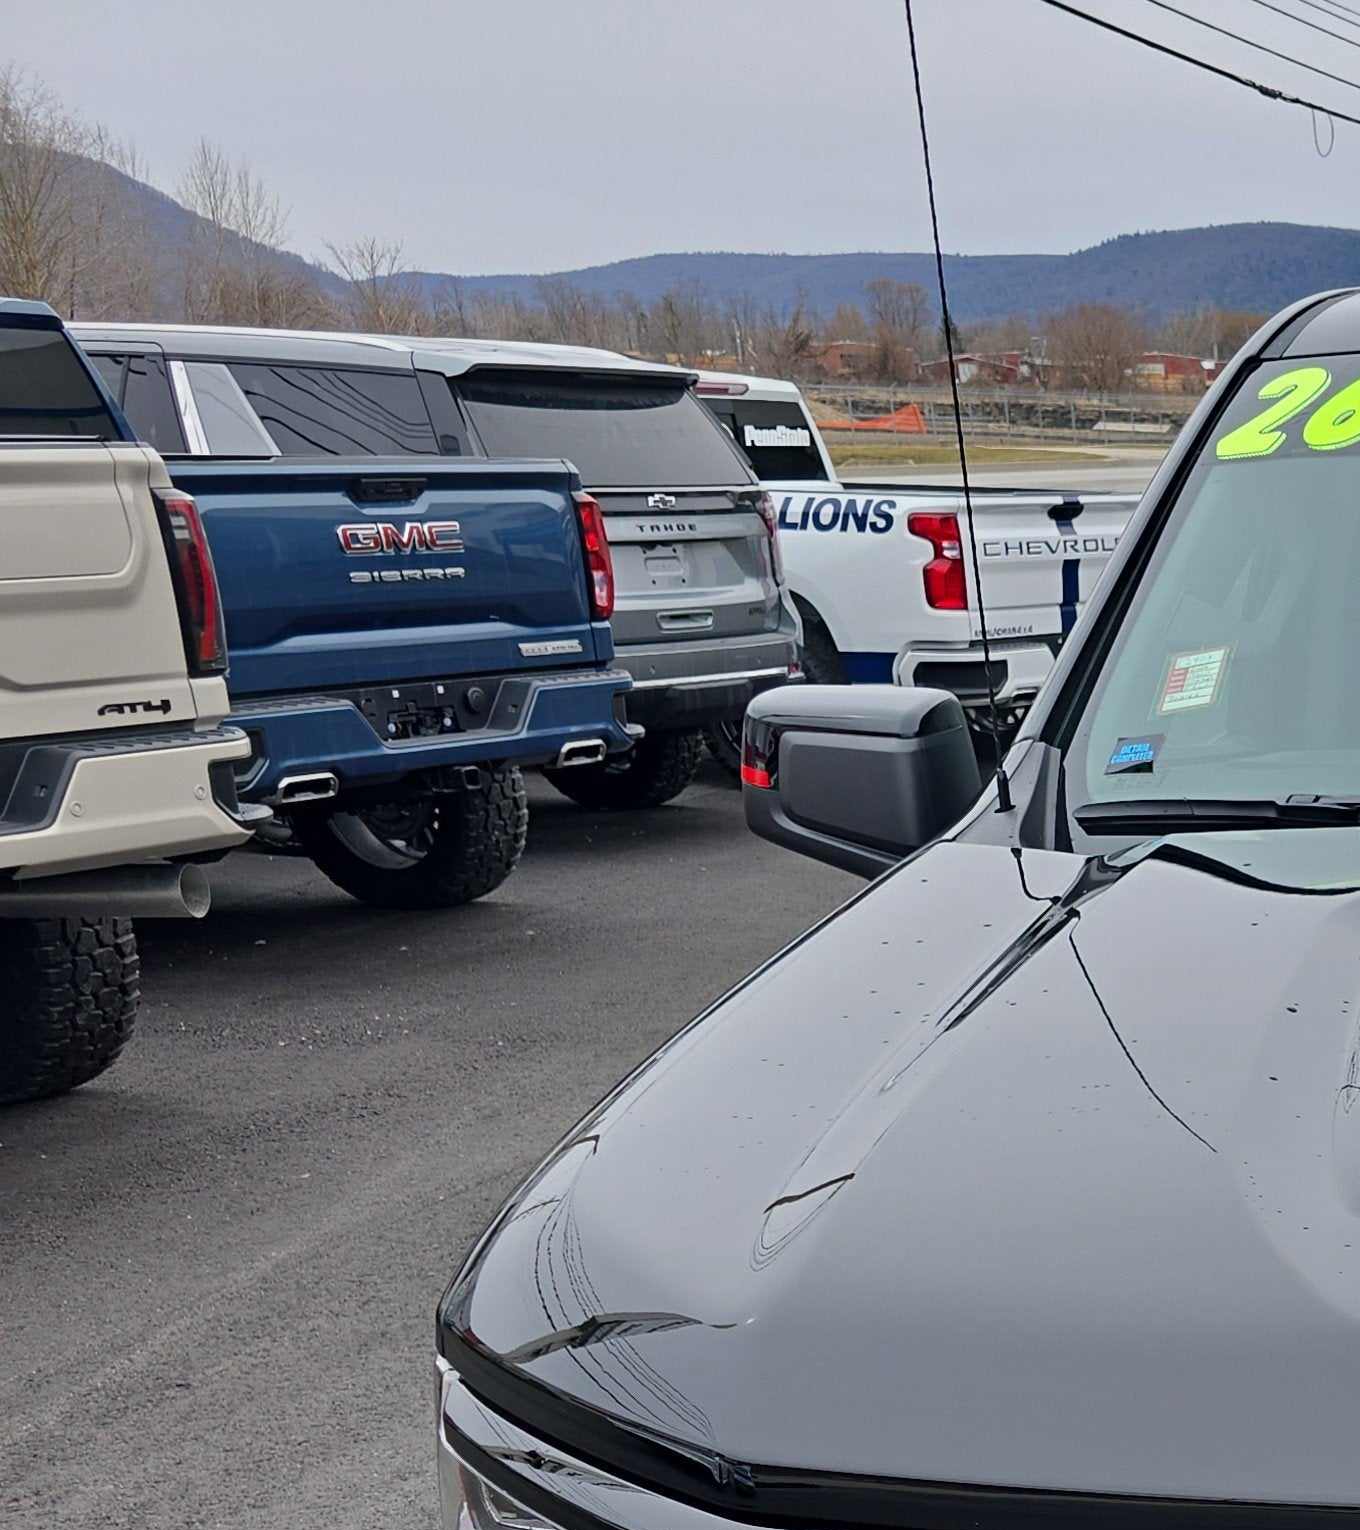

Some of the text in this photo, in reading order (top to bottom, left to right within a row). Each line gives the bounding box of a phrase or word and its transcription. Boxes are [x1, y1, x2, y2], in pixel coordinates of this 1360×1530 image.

[778, 497, 897, 534] LIONS
[636, 524, 697, 532] TAHOE
[336, 521, 465, 556] GMC
[983, 537, 1119, 557] CHEVROL
[350, 567, 465, 583] SIERRA
[97, 699, 171, 716] AT4
